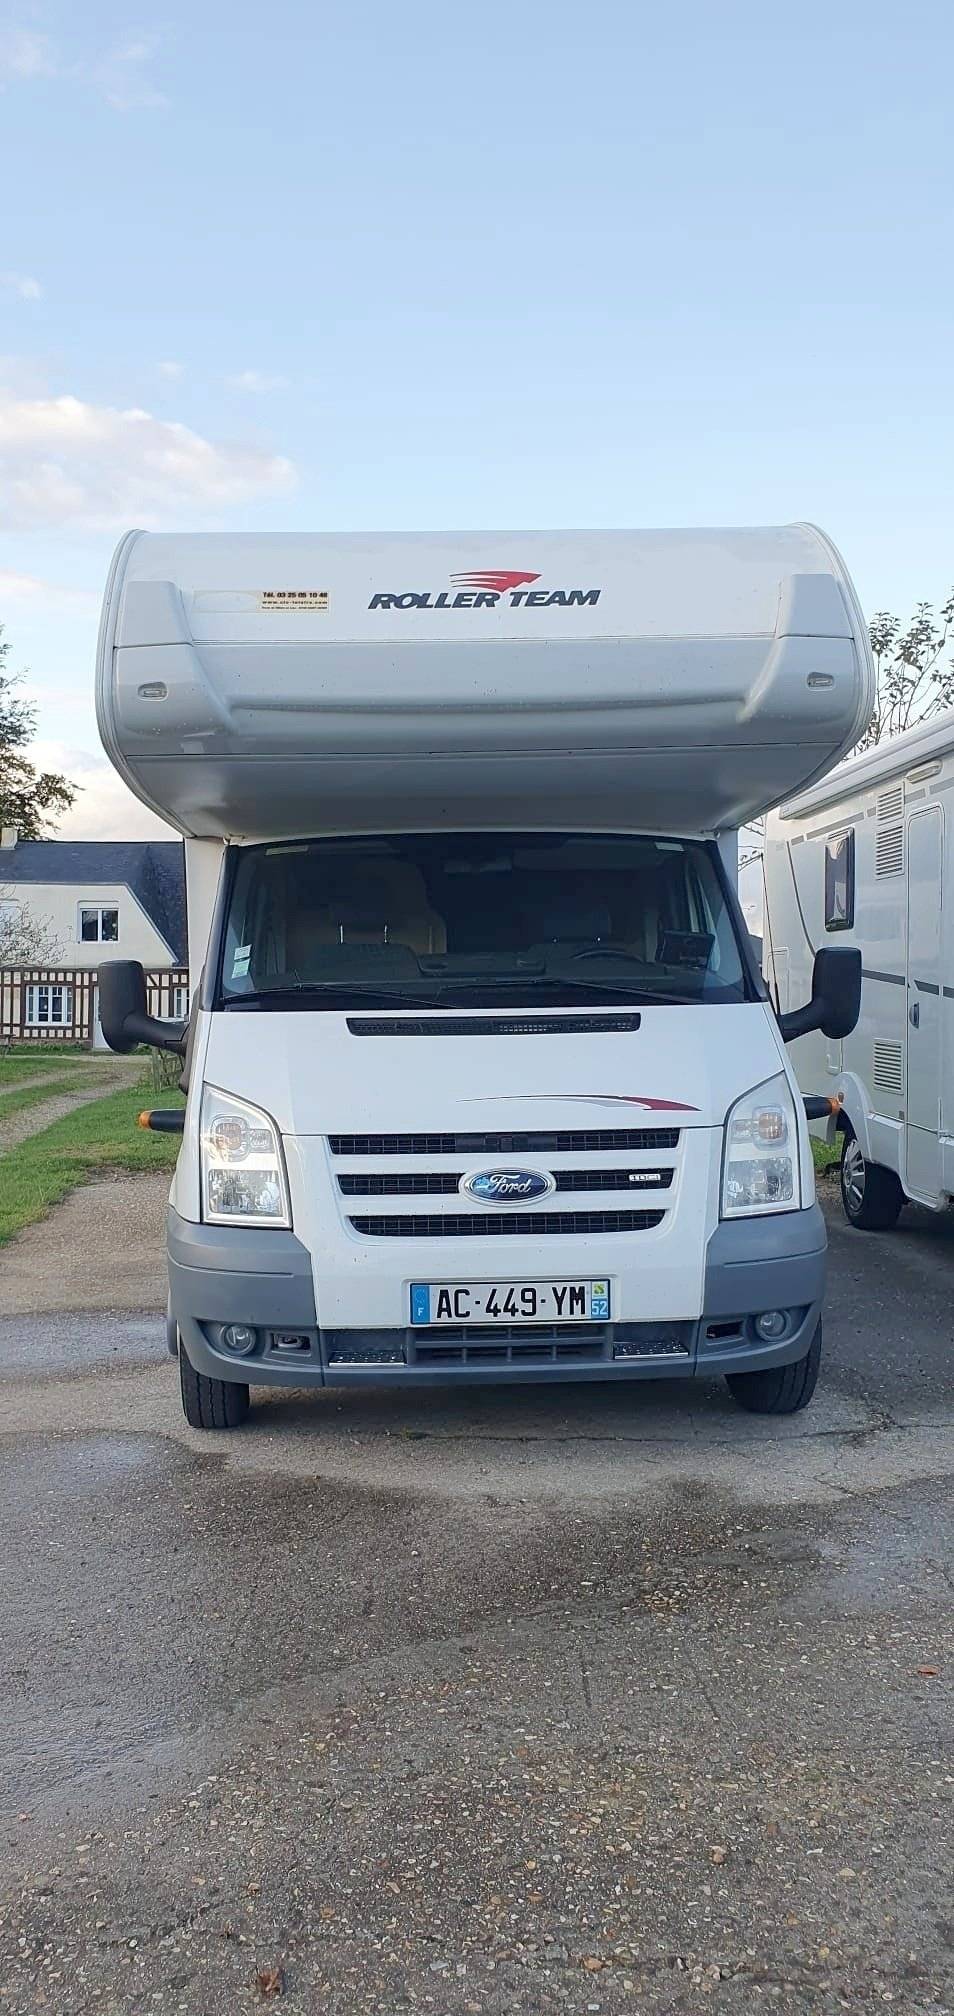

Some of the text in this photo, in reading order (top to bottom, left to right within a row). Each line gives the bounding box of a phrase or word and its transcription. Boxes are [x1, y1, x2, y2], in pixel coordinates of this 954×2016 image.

[368, 590, 601, 609] ROLLER TEAM
[487, 1173, 531, 1194] Ford
[418, 1286, 608, 1318] F AC-449-YM 52
